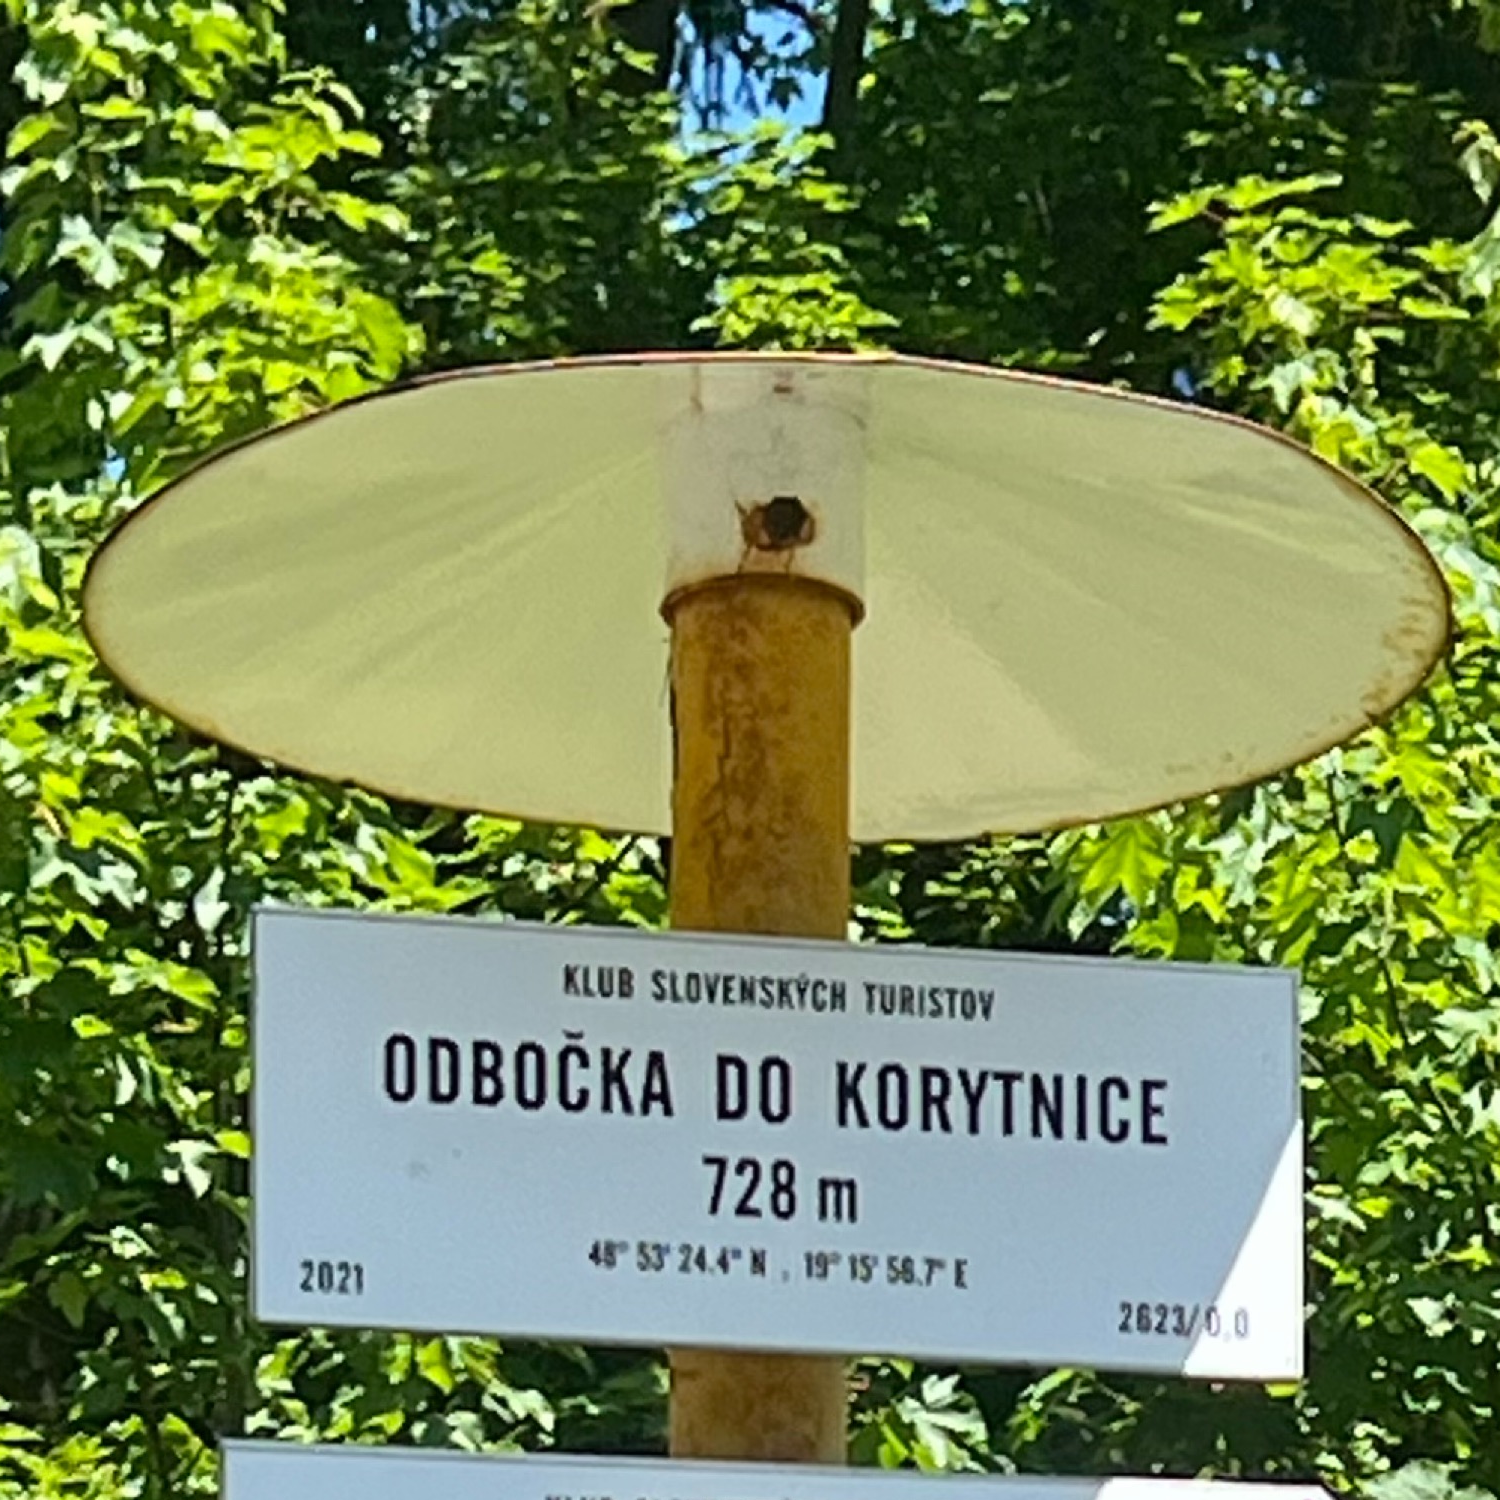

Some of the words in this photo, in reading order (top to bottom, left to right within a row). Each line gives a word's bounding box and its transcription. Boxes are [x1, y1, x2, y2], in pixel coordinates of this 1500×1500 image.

[563, 963, 634, 999] KLUB
[650, 968, 847, 1014] SLOVENSKÝCH
[863, 979, 996, 1022] TURISTOV
[383, 1028, 675, 1118] ODBOČKA
[715, 1053, 792, 1124] DO
[836, 1060, 1169, 1146] KORYTNICE
[702, 1155, 798, 1221] 728
[817, 1176, 859, 1224] m
[298, 1258, 365, 1296] 2021
[954, 1258, 969, 1290] E
